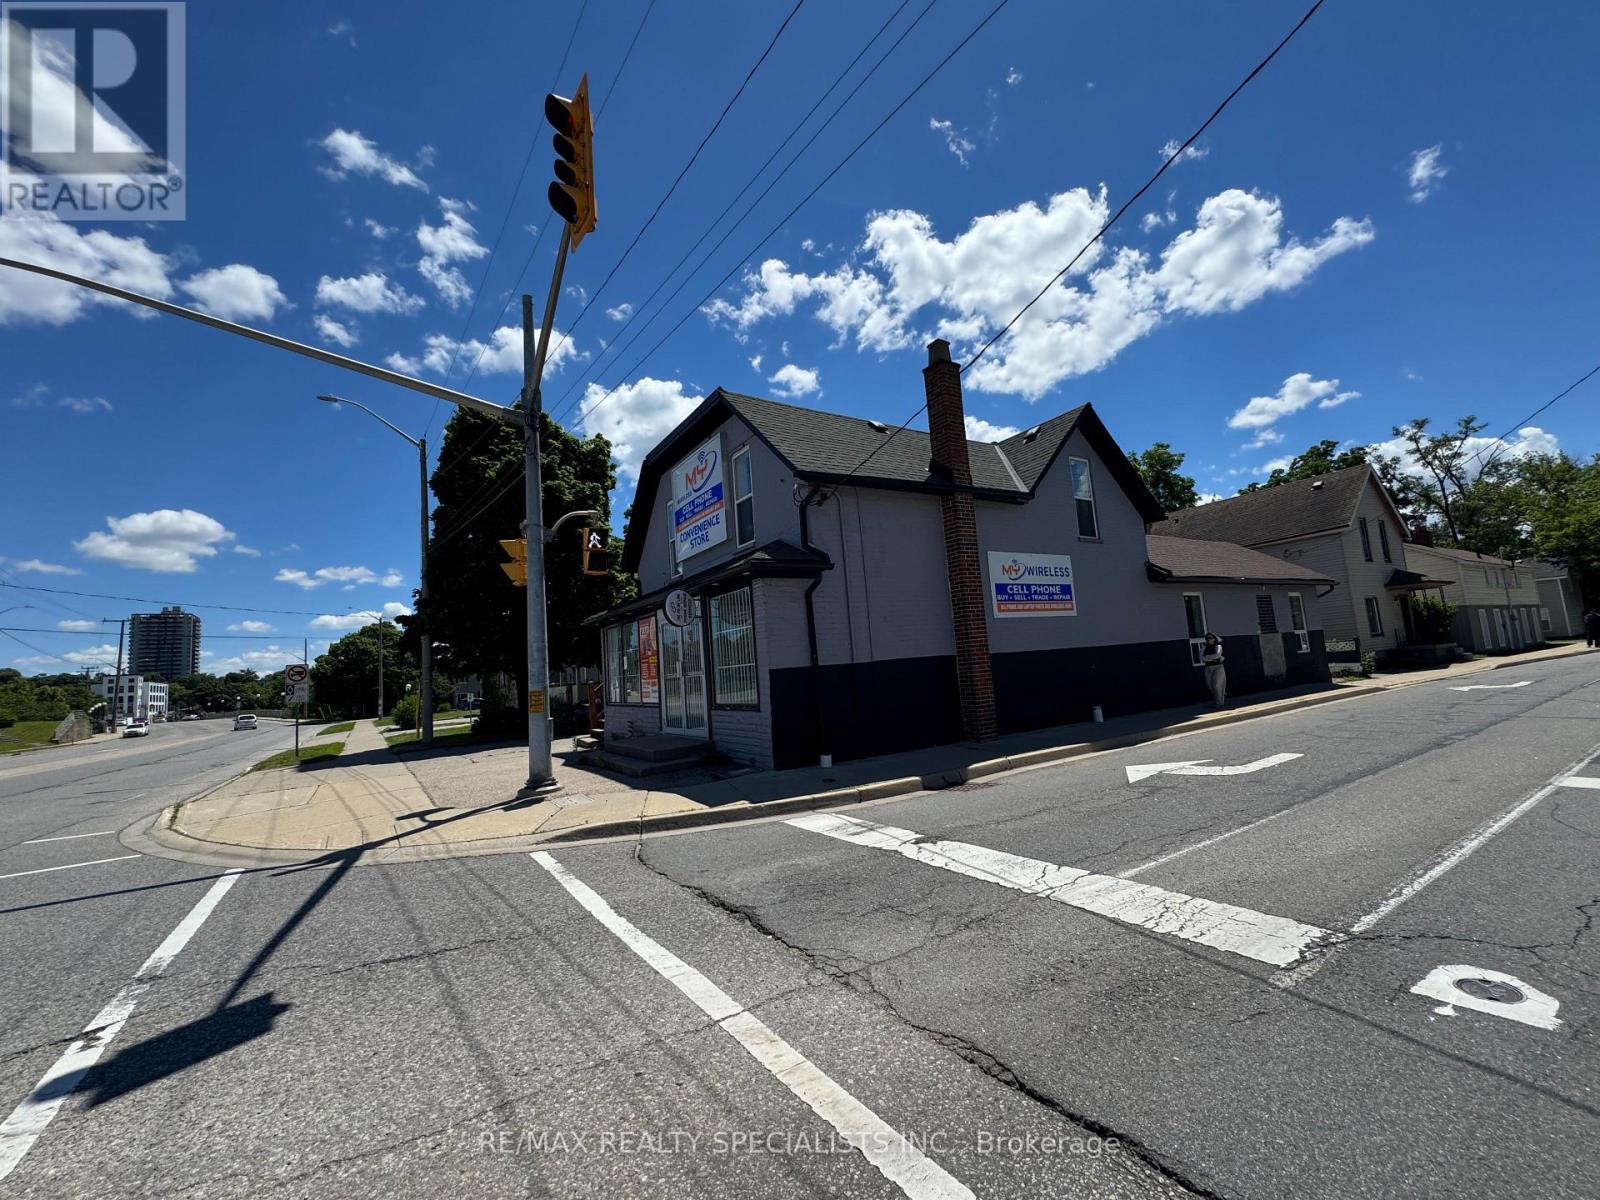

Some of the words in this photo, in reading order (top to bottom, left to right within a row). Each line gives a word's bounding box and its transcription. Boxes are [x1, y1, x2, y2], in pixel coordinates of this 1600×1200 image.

[680, 513, 720, 543] CONVENIENCE
[689, 531, 710, 549] STORE
[1026, 565, 1070, 577] WIRELESS
[1007, 585, 1029, 594] CELL
[1031, 585, 1062, 594] PHONE
